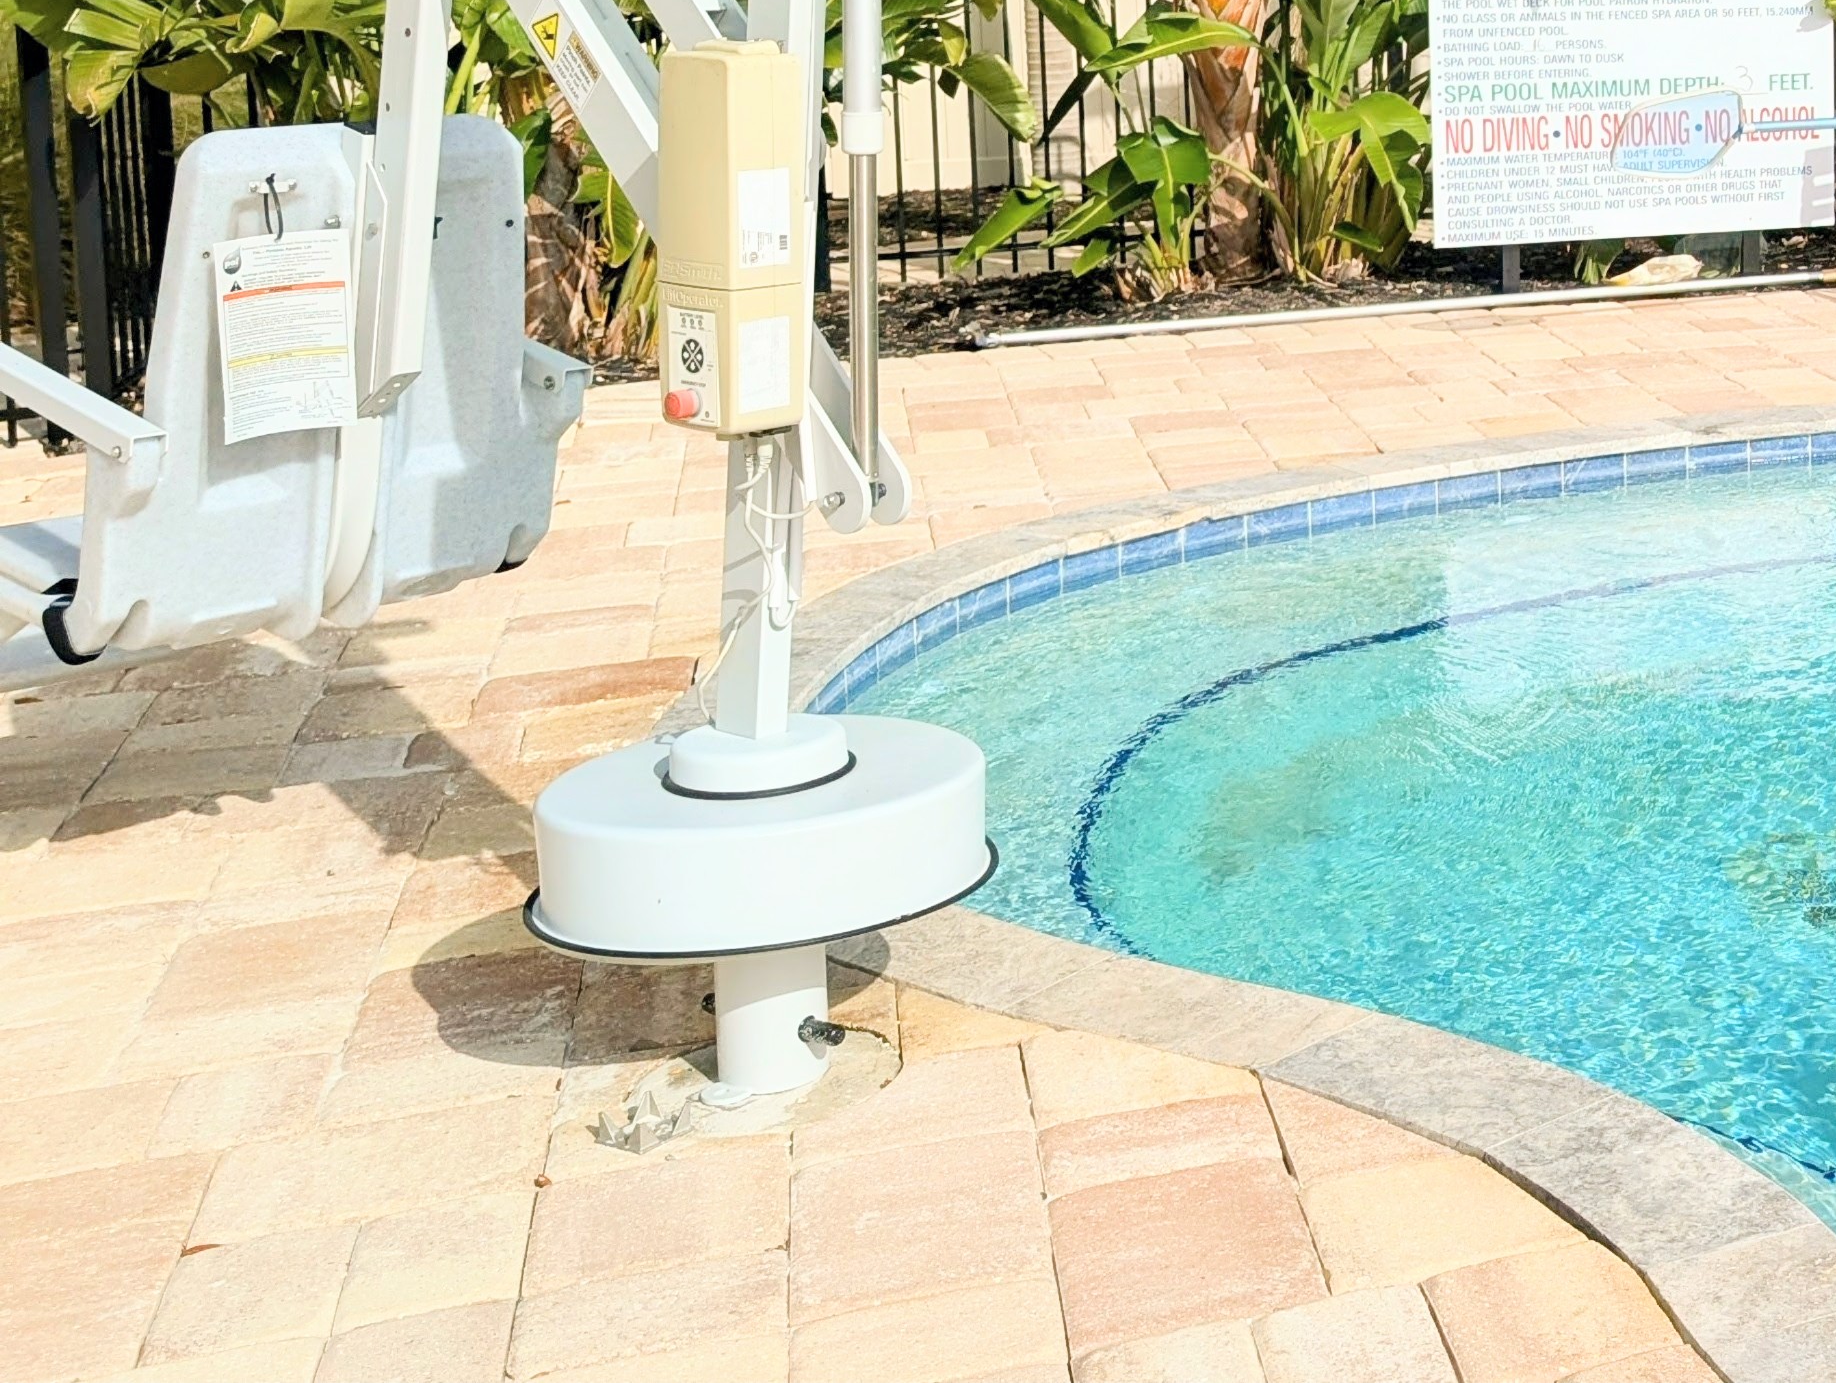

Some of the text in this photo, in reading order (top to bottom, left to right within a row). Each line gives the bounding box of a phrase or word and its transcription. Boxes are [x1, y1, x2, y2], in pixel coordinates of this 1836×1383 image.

[1442, 0, 1462, 9] THE
[1466, 0, 1493, 9] POOL
[1442, 14, 1458, 24] NO
[1462, 13, 1496, 23] GLASS
[1500, 13, 1516, 22] OR
[1520, 12, 1566, 22] ANIMALS
[1570, 11, 1581, 21] IN
[1586, 11, 1606, 21] THE
[1608, 10, 1648, 20] FENCED
[1652, 9, 1672, 19] SPA
[1674, 8, 1700, 19] AREA
[1704, 8, 1718, 18] OR
[1722, 7, 1734, 18] 50
[1442, 28, 1474, 38] FROM
[1478, 27, 1535, 38] UNFENCED
[1444, 42, 1490, 53] BATHING
[1494, 42, 1524, 52] LOAD:
[1556, 40, 1606, 50] PERSONS.
[1444, 53, 1624, 68] SPA POOL HOURS: DAWN TO DUSK
[1444, 68, 1592, 82] SHOWER BEFORE ENTERING.
[1444, 84, 1483, 103] SPA
[1491, 82, 1544, 101] POOL
[1551, 78, 1650, 99] MAXIMUM
[1768, 73, 1814, 91] FEET.
[1444, 106, 1460, 117] DO
[1464, 106, 1484, 116] NOT
[1490, 104, 1540, 115] SWALLOW
[1546, 103, 1564, 113] THE
[1568, 102, 1596, 112] POOL
[1445, 118, 1474, 154] NO
[1482, 115, 1549, 153] DIVING
[1565, 114, 1593, 150] NO
[1600, 110, 1690, 148] SMOKING
[1704, 109, 1731, 144] NO
[1446, 155, 1500, 167] MAXIMUM
[1504, 154, 1538, 165] WATER
[1542, 150, 1618, 163] TEMPERATUR:
[1446, 167, 1500, 180] CHILDREN
[1504, 166, 1540, 177] UNDER
[1545, 165, 1556, 175] 12
[1560, 163, 1588, 174] MUST
[1623, 161, 1654, 171] ADULT
[1446, 180, 1504, 192] PREGNANT
[1556, 176, 1588, 187] SMALL
[1720, 169, 1756, 180] HEALTH
[1760, 166, 1812, 178] PROBLEMS
[1447, 194, 1470, 205] AND
[1474, 192, 1512, 204] PEOPLE
[1516, 191, 1550, 202] USING
[1608, 185, 1664, 197] NARCOTICS
[1668, 184, 1682, 194] OR
[1686, 183, 1718, 194] OTHER
[1722, 181, 1756, 192] DRUGS
[1759, 179, 1782, 190] THAT
[1448, 192, 1786, 218] CAUSE DROWSINESS SHOULD NOT USE SPA POOLS WITHOUT FIRST
[1448, 214, 1574, 230] CONSULTING A DOCTOR.
[1448, 230, 1501, 243] MAXIMUM
[1534, 228, 1544, 239] 15
[1548, 226, 1598, 238] MINUTES.
